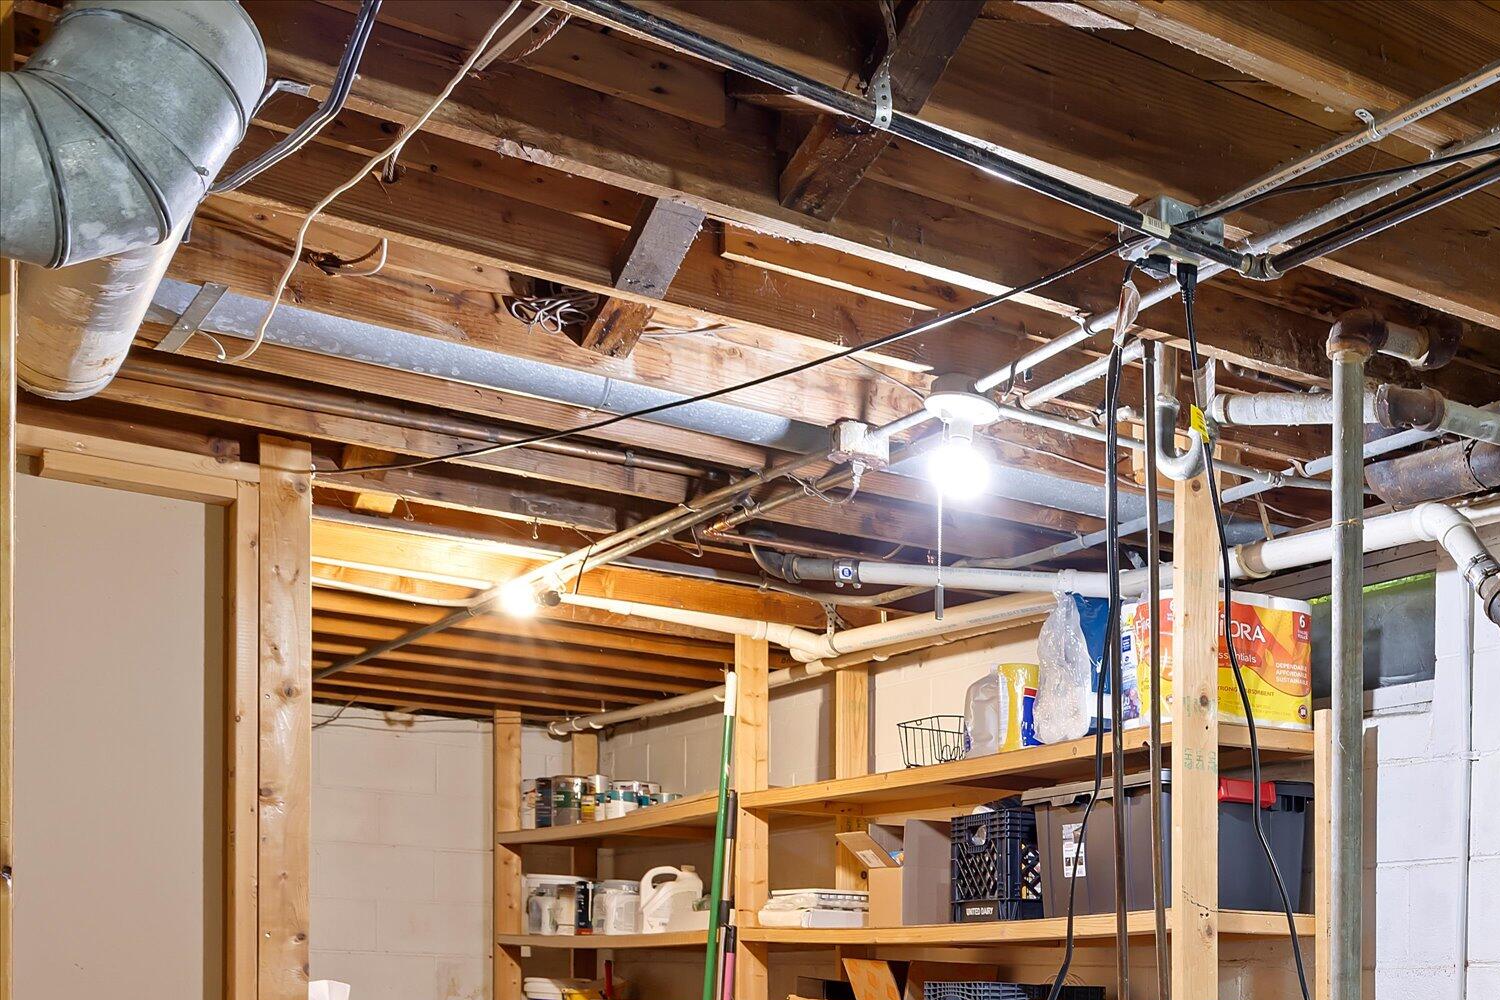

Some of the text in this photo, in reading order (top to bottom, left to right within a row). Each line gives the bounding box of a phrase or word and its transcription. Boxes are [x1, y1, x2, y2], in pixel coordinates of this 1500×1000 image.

[1299, 614, 1306, 628] 6
[965, 906, 994, 916] UNITED DAIRY
